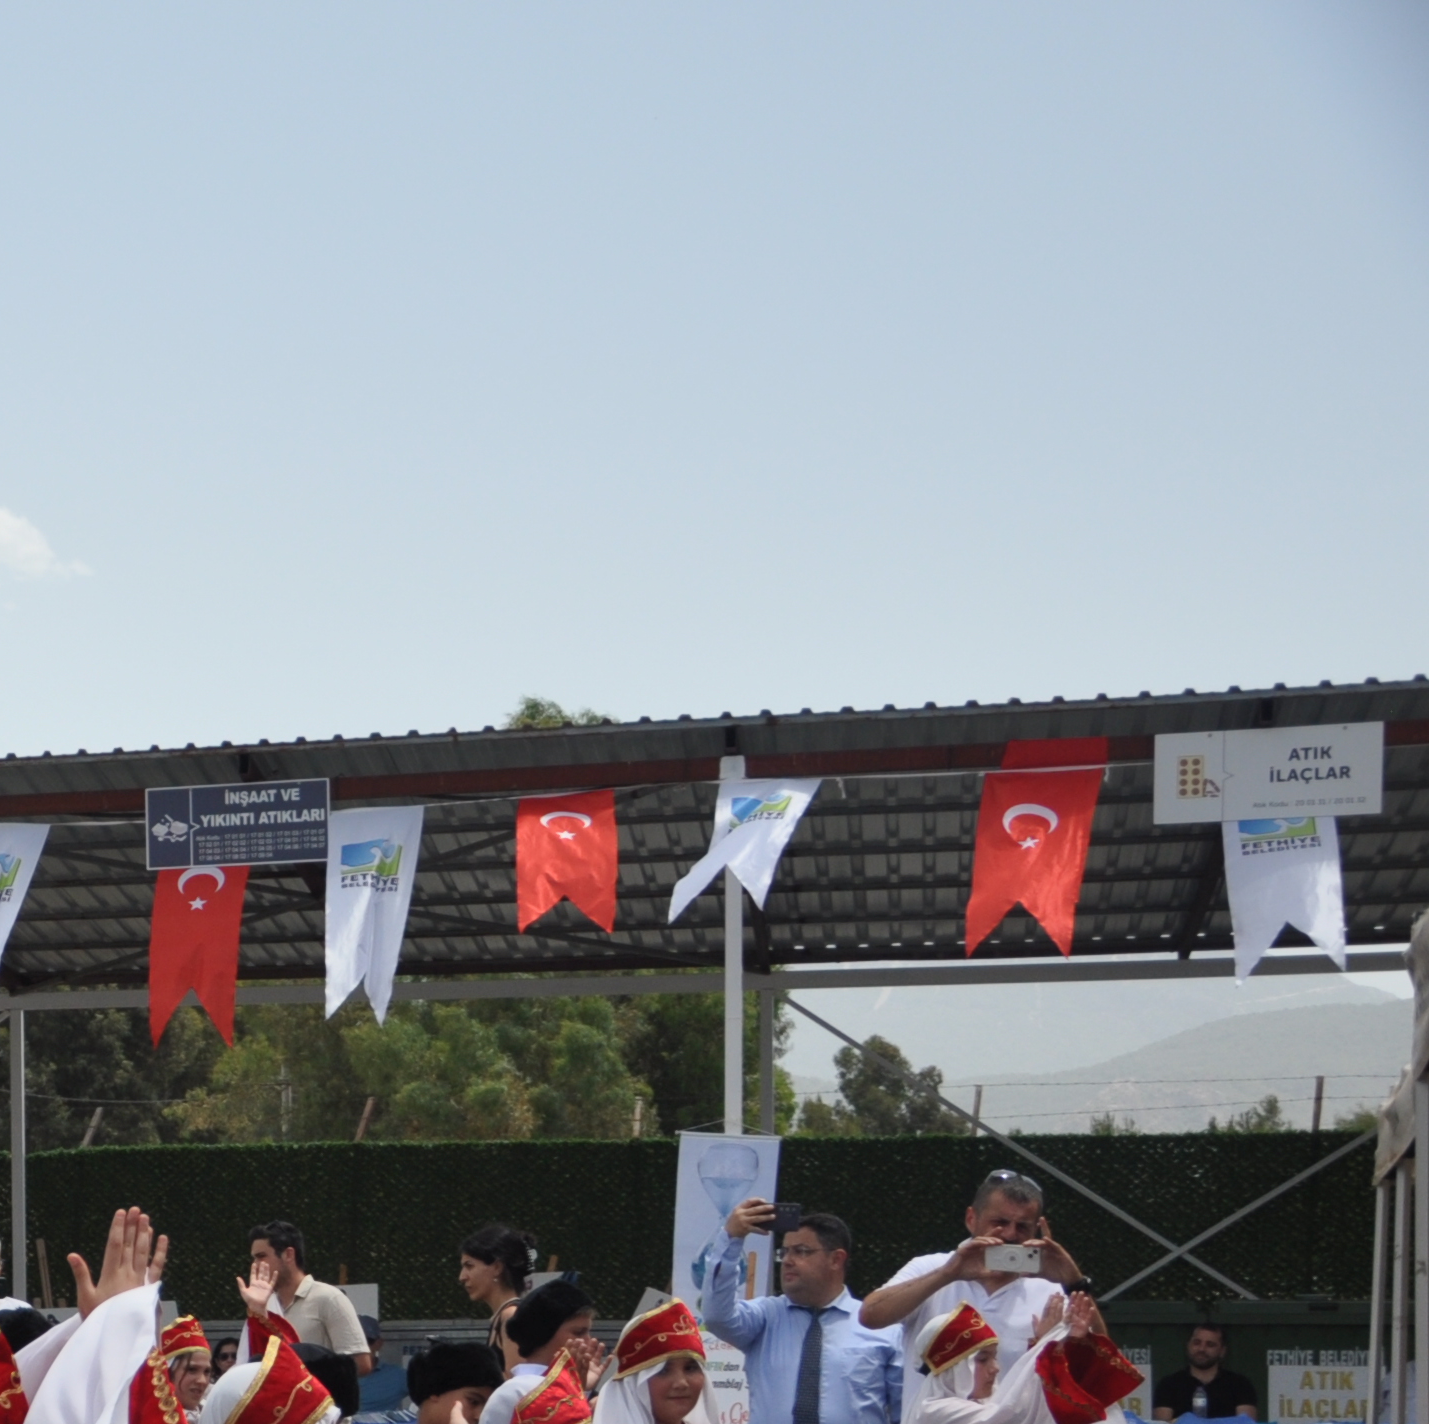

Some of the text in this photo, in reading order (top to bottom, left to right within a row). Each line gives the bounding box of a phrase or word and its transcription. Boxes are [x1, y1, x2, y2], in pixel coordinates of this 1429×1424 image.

[1288, 746, 1332, 761] ATIK
[1269, 766, 1351, 784] İLAÇLAR
[225, 788, 300, 807] İNŞAAT VE
[200, 808, 325, 828] YIKINTI ATIKLARI
[1267, 1346, 1313, 1366] FETHİYE
[1299, 1371, 1354, 1390] ATIK
